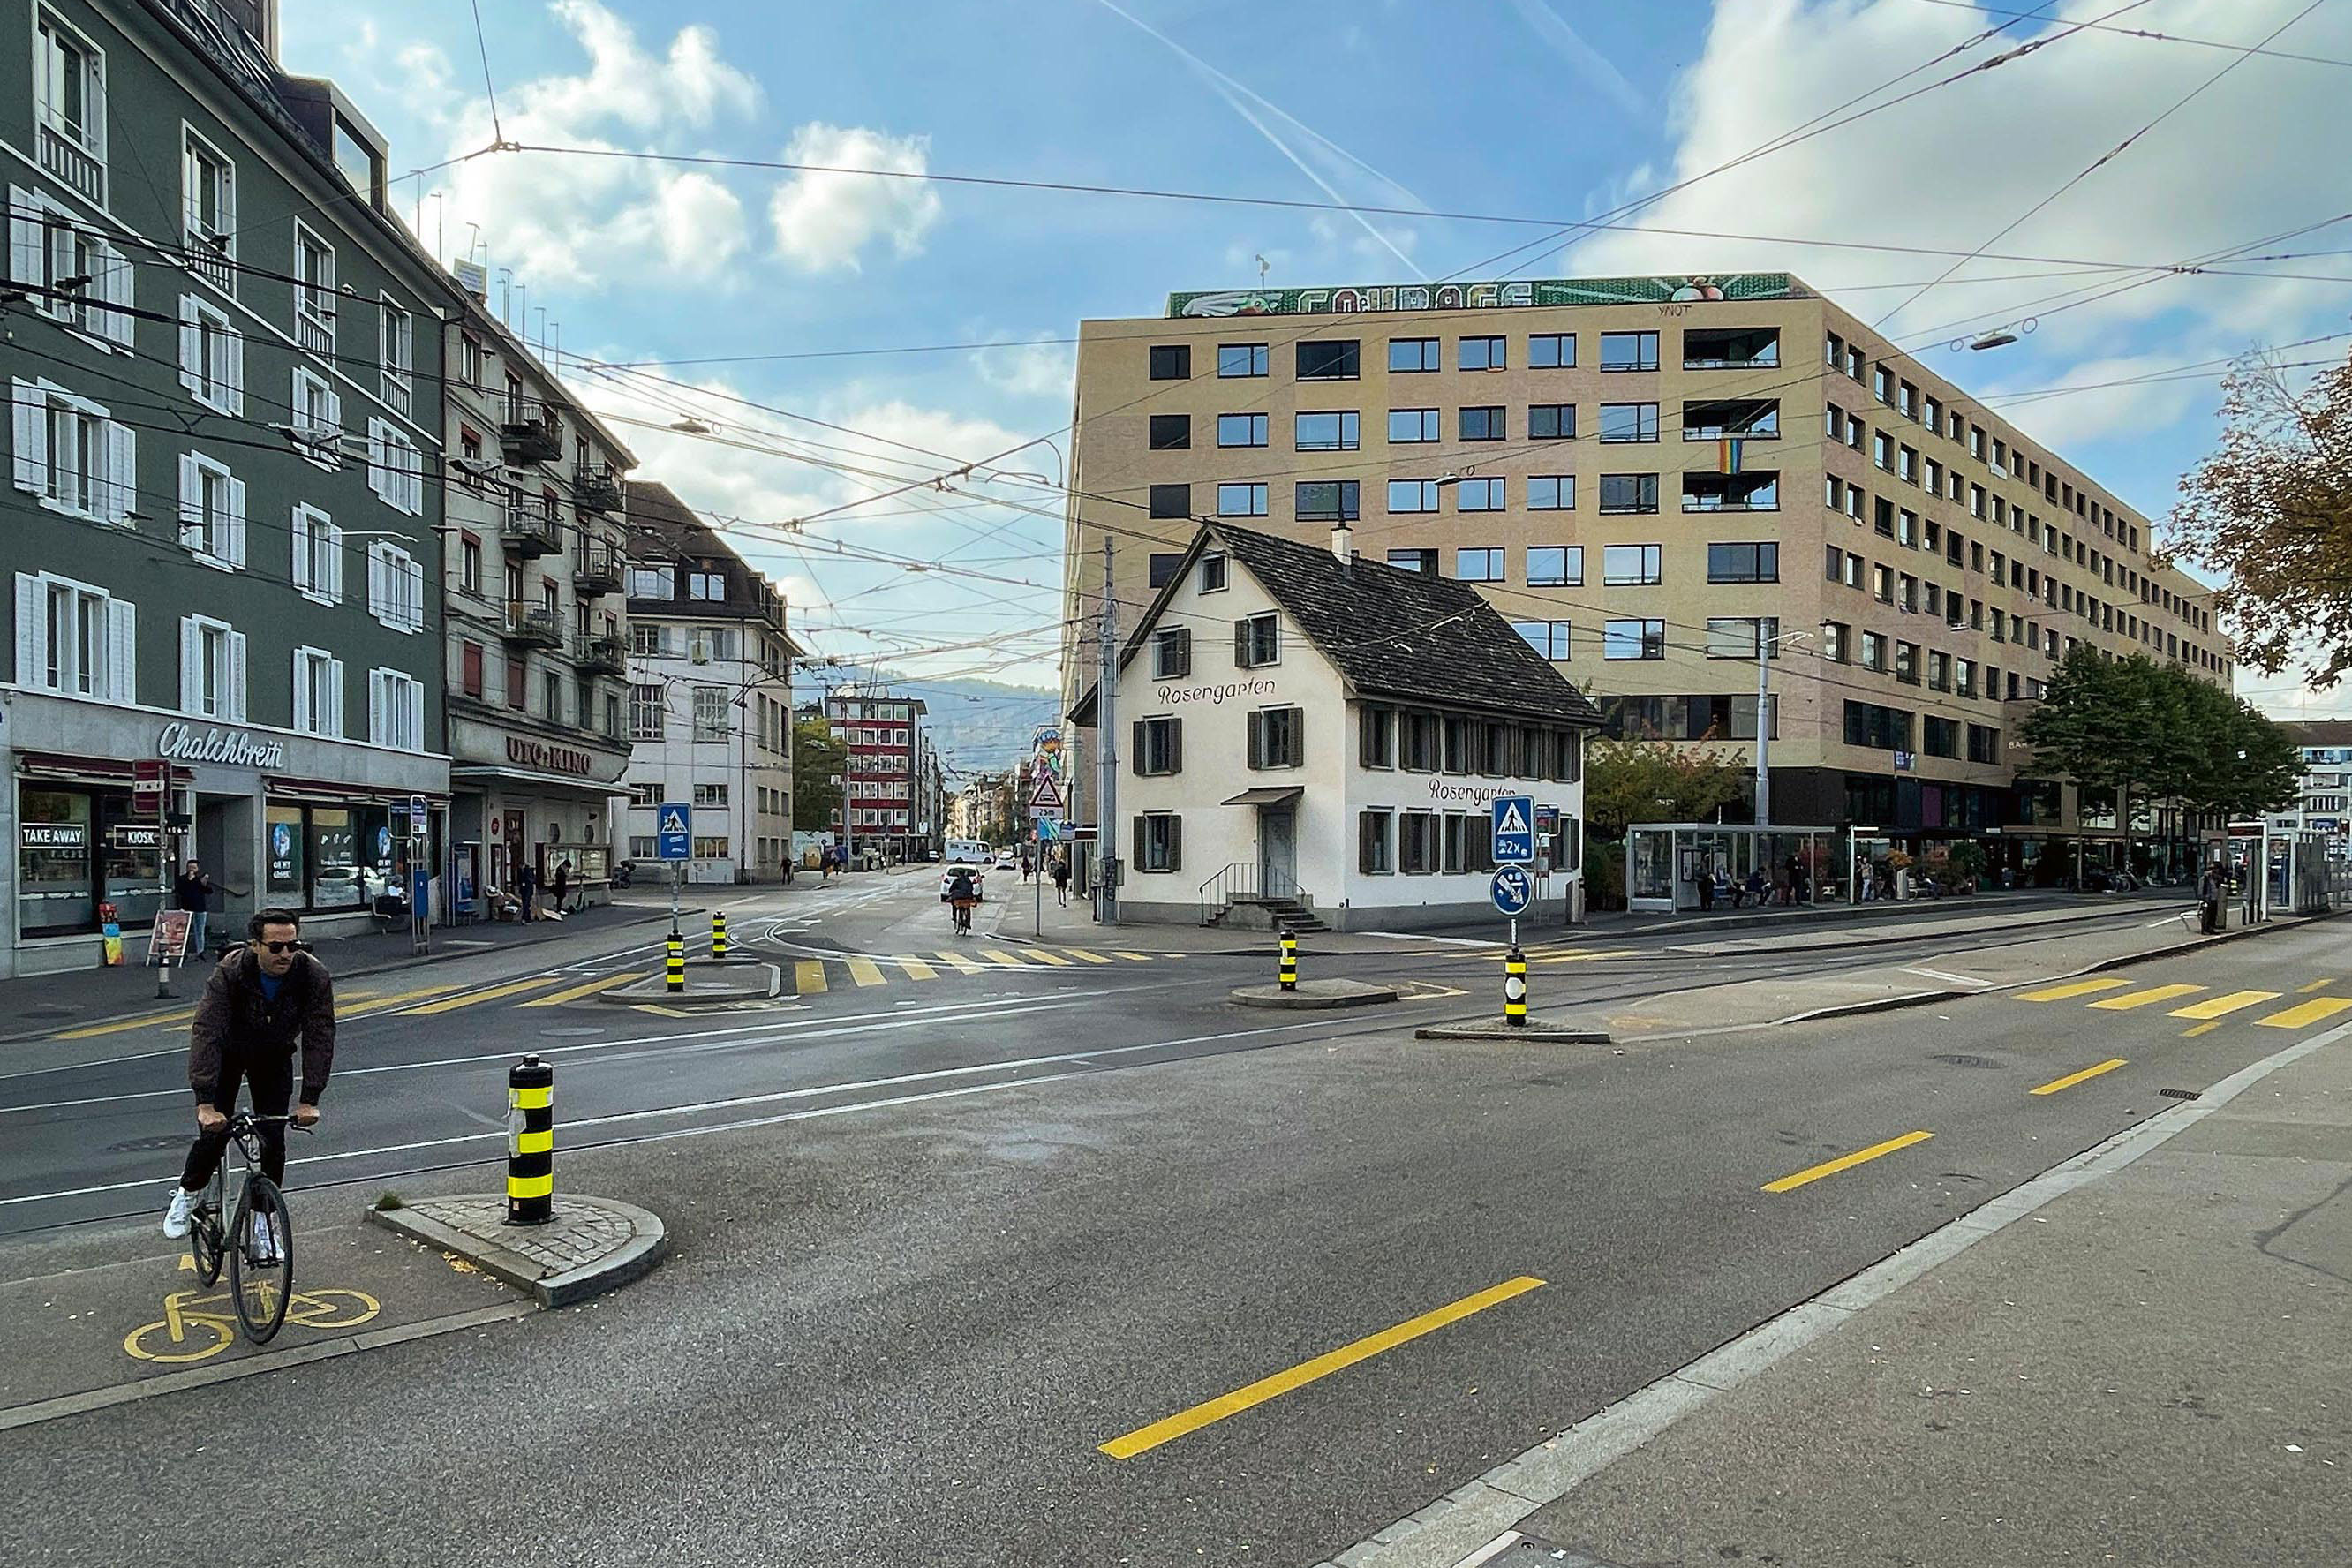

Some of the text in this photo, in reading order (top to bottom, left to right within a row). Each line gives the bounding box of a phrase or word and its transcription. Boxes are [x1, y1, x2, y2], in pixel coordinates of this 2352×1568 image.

[1658, 305, 1692, 317] YNOT
[1158, 677, 1276, 705] Rosengarten
[159, 722, 283, 767] Chalchbreiti
[23, 829, 82, 844] TAKE AWAY
[127, 831, 155, 844] KIOSK
[1506, 841, 1520, 854] 2x
